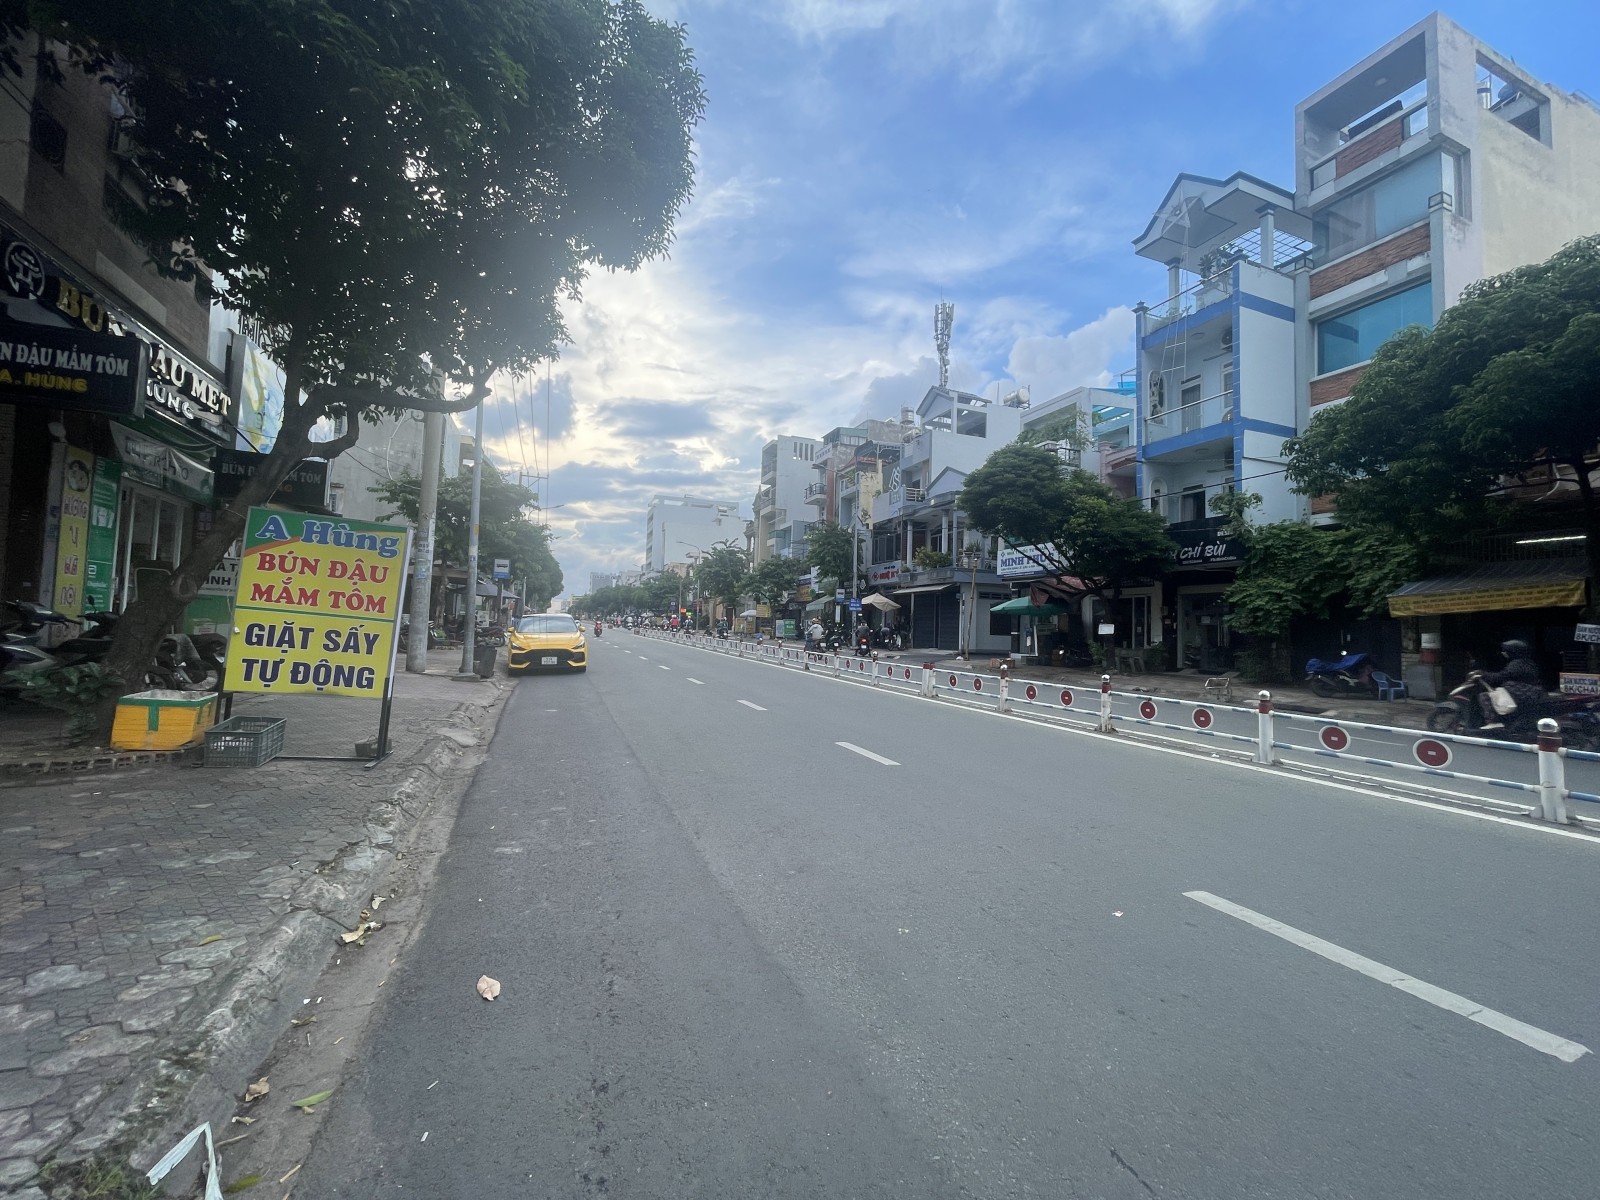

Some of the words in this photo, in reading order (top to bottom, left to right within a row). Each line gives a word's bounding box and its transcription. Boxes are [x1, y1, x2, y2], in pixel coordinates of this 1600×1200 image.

[16, 341, 53, 368] ĐẬU
[55, 344, 93, 372] MẮM
[96, 353, 130, 377] TÔM
[149, 341, 187, 387] ẬU
[255, 515, 291, 541] A
[300, 519, 402, 559] Hùng
[1204, 540, 1227, 557] BÙI
[256, 550, 321, 577] BÚN
[327, 557, 390, 586] ĐẬU
[1001, 556, 1024, 567] MINH
[250, 576, 321, 607] MẮM
[328, 586, 388, 614] TÔM
[245, 620, 315, 654] GIẶT
[322, 624, 380, 655] SẤY
[241, 658, 286, 688] TỰ
[289, 658, 376, 691] ĐỘNG
